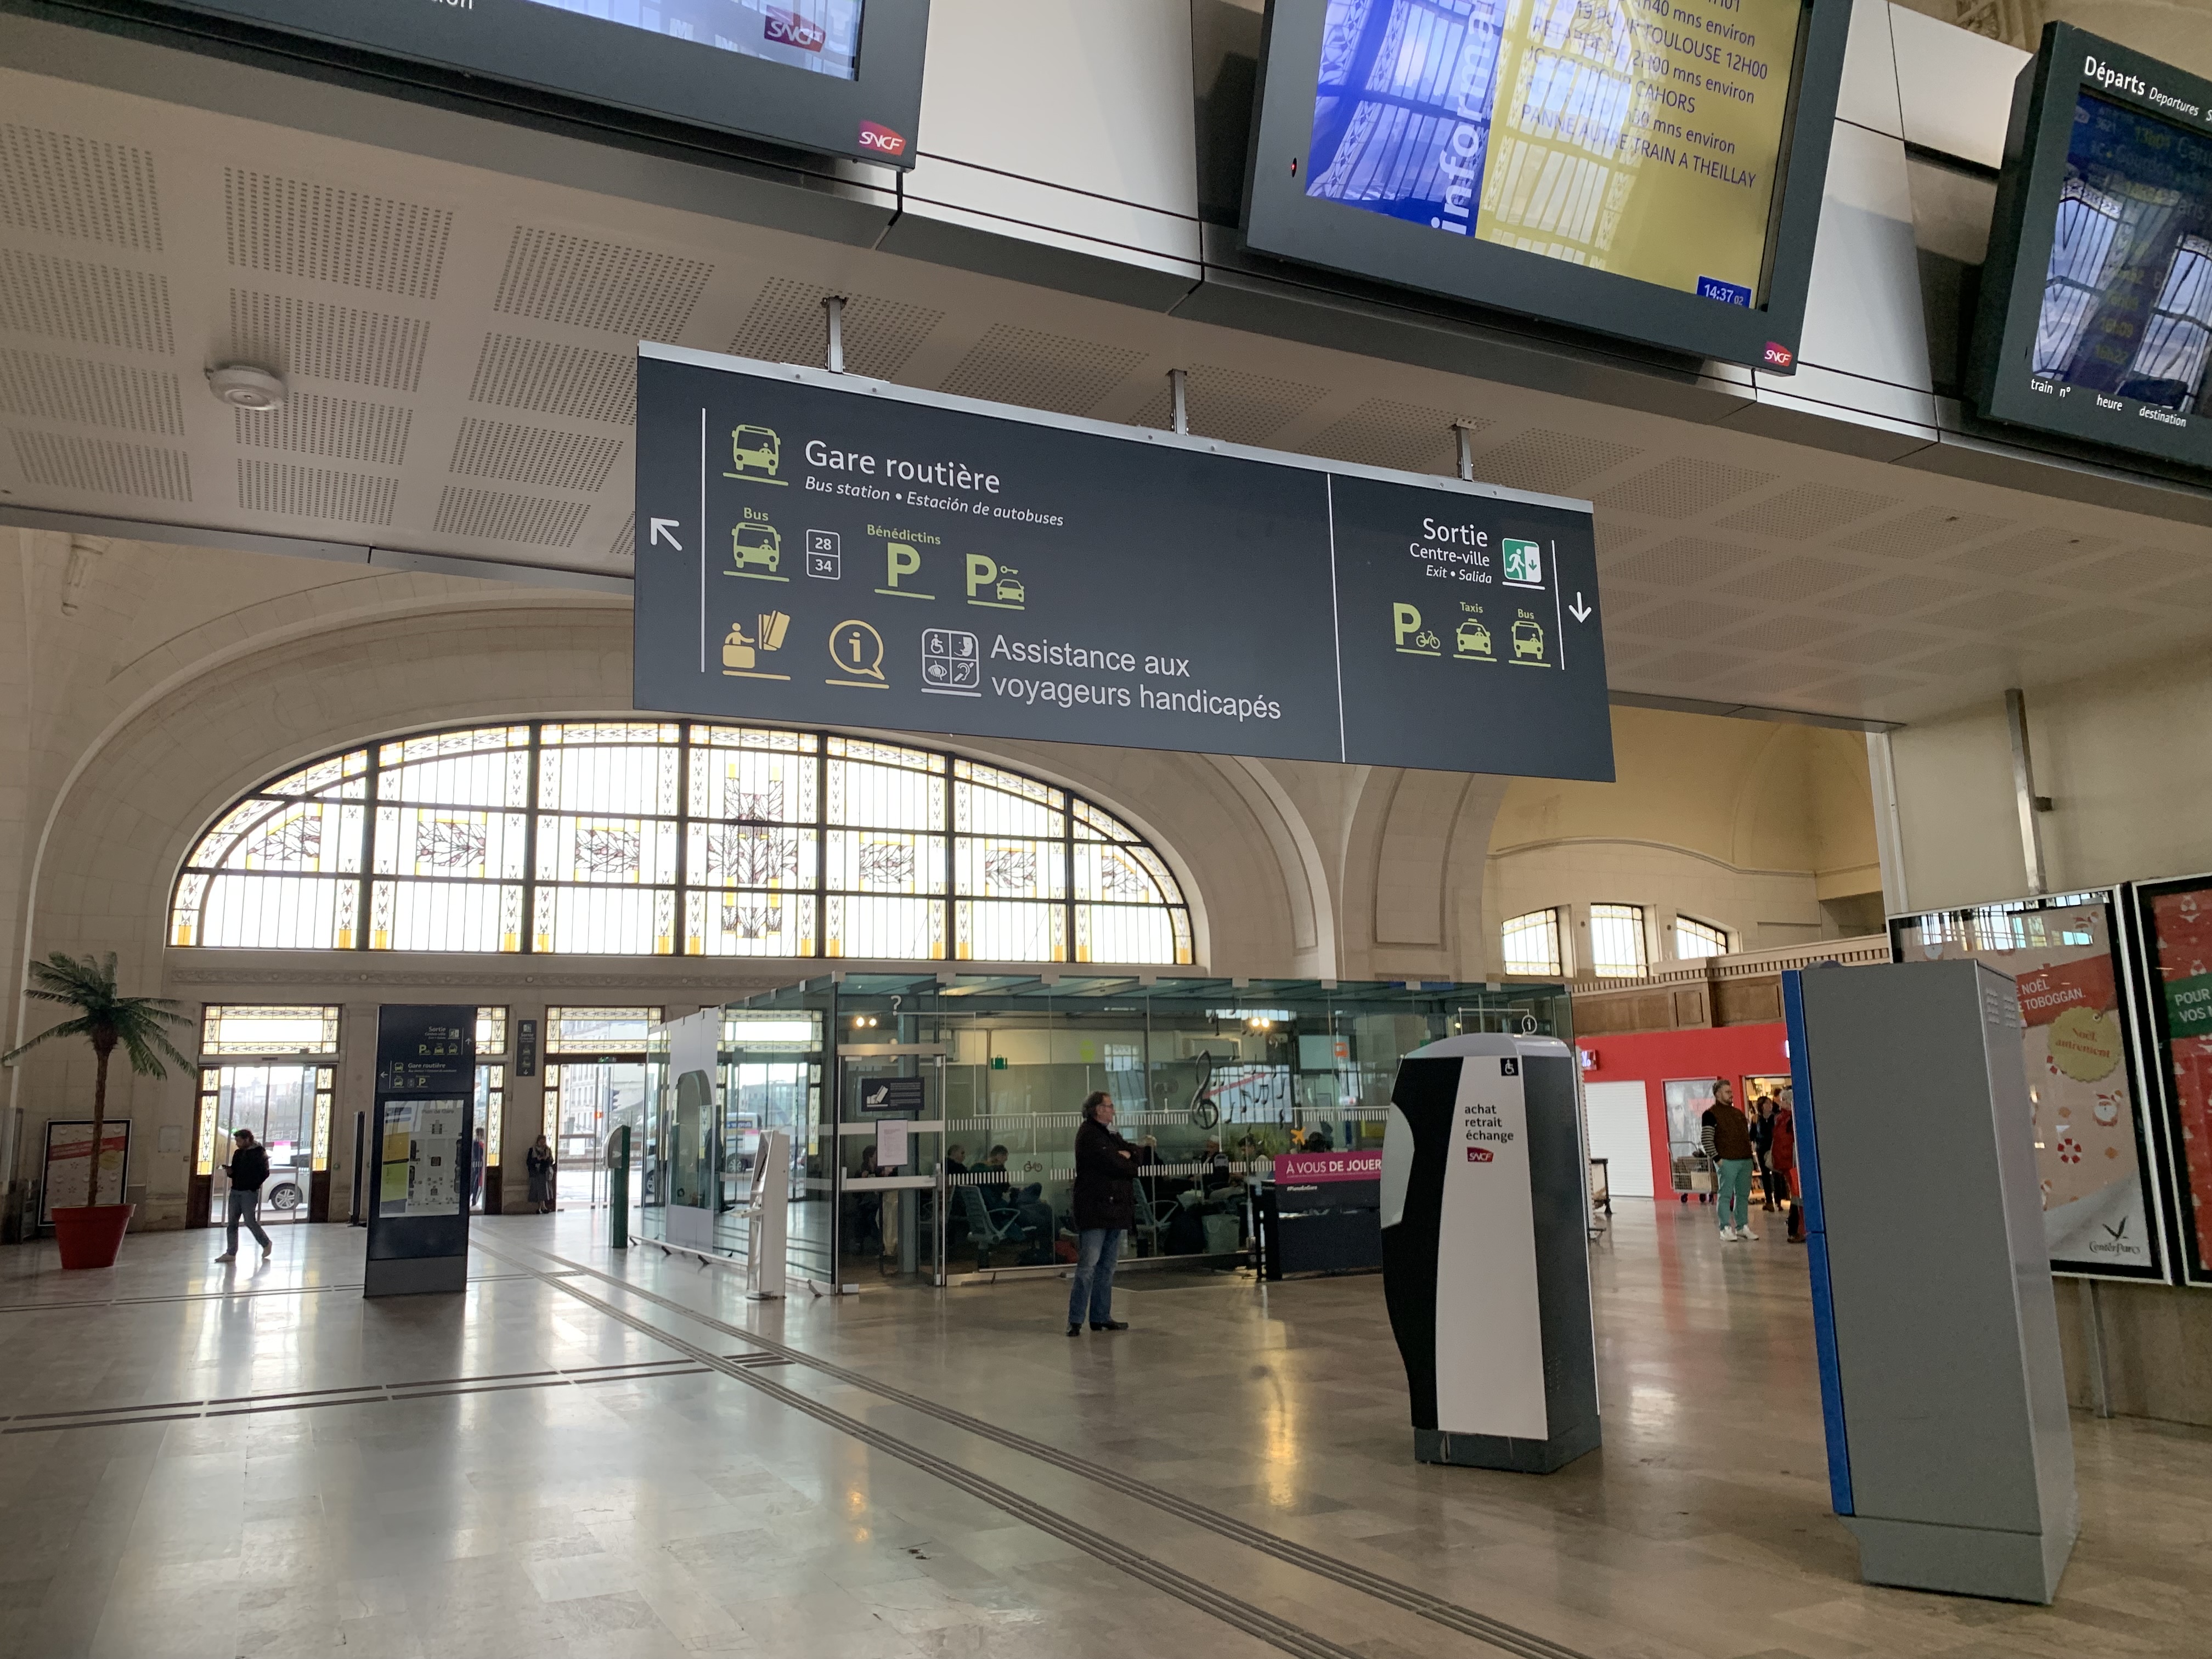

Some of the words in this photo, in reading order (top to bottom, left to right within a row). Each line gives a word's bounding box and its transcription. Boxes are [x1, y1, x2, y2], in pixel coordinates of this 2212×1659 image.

[767, 20, 823, 45] SNCF
[1673, 8, 1702, 28] mns
[1706, 20, 1755, 47] environ
[1645, 24, 1722, 64] TOULOUSE
[1726, 52, 1768, 80] 12H00
[1633, 49, 1669, 76] 2H00
[1674, 66, 1701, 87] mns
[1706, 77, 1754, 104] environ
[2084, 56, 2146, 95] Départs
[2149, 87, 2199, 116] Departures
[1636, 80, 1696, 113] CAHORS
[859, 131, 903, 150] SNCF
[1521, 104, 1575, 136] PANNE
[1579, 124, 1628, 150] AUTRE
[1634, 137, 1675, 165] TRAIN
[1679, 153, 1688, 169] A
[1694, 155, 1756, 188] THEILLAY
[1653, 118, 1681, 138] mns
[1686, 129, 1735, 154] environ
[1704, 284, 1734, 302] 14:37
[1734, 295, 1744, 306] 02
[1764, 349, 1791, 364] SNCF
[2031, 379, 2053, 394] train
[2059, 386, 2071, 398] n°
[2096, 394, 2123, 411] heure
[2139, 406, 2187, 427] destination
[805, 439, 876, 475] Gare
[887, 456, 1001, 493] routière
[805, 476, 833, 493] Bus
[837, 481, 890, 502] station
[906, 492, 969, 514] Estación
[972, 499, 990, 517] de
[993, 503, 1064, 527] autobuses
[743, 507, 769, 522] Bus
[866, 524, 941, 545] Bénédictins
[1423, 518, 1488, 547] Sortie
[814, 537, 832, 551] 28
[814, 558, 833, 573] 34
[887, 542, 922, 588] P
[1409, 543, 1491, 567] Centre-ville
[966, 552, 997, 597] P
[1426, 565, 1447, 578] Exit
[1458, 569, 1492, 584] Salida
[1459, 601, 1484, 614] Taxis
[1517, 608, 1534, 620] Bus
[1393, 602, 1422, 646] P
[990, 634, 1136, 672] Assistance
[1144, 656, 1190, 677] aux
[991, 676, 1131, 708] voyageurs
[1139, 684, 1282, 722] handicapés
[2021, 979, 2050, 995] NOËL
[2174, 988, 2211, 1006] POUR
[2178, 1007, 2207, 1023] VOS
[1464, 1103, 1497, 1114] achat
[1465, 1116, 1503, 1127] retrait
[1466, 1130, 1514, 1144] échange
[1286, 1160, 1295, 1174] À
[1296, 1161, 1326, 1174] VOUS
[1329, 1160, 1344, 1172] DE
[1346, 1159, 1381, 1172] JOUER
[1469, 1152, 1492, 1161] SNCF
